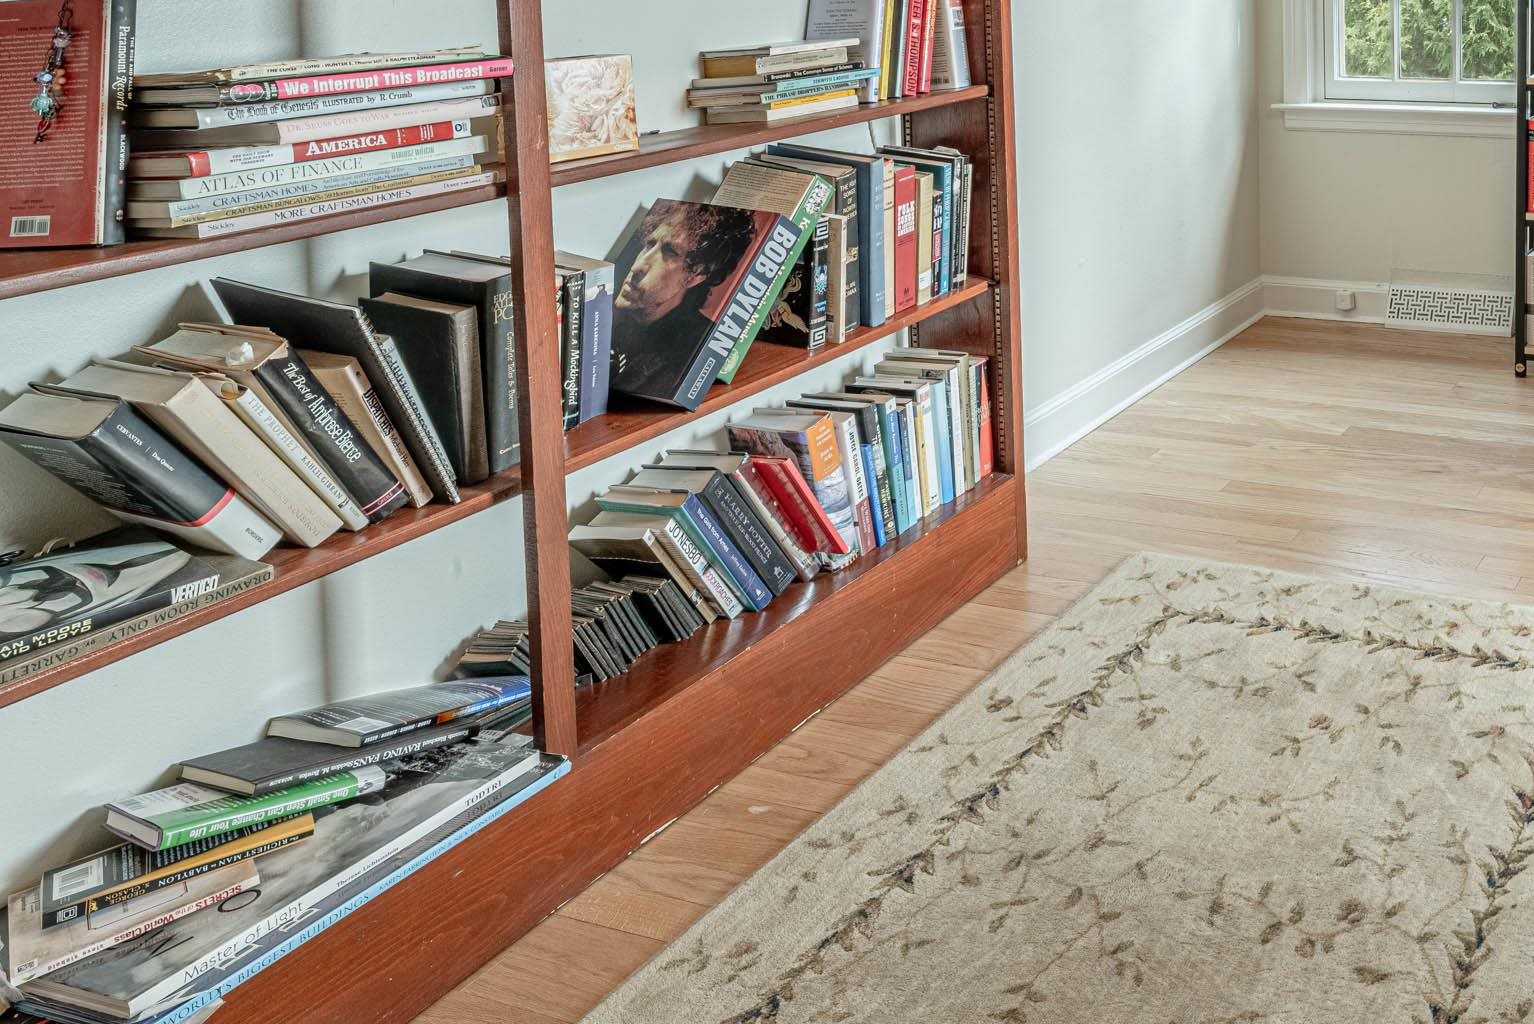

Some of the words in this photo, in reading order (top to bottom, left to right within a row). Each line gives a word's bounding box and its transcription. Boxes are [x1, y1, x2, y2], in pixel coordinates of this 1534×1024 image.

[911, 21, 920, 32] S.
[118, 25, 131, 75] Paramount
[794, 69, 802, 77] The
[803, 67, 820, 76] Common
[821, 66, 833, 74] Sense
[838, 64, 853, 72] Science
[907, 34, 920, 92] THOMPSON
[284, 79, 308, 96] We
[312, 73, 379, 94] Interrupt
[383, 71, 412, 87] This
[416, 65, 483, 84] Broadcast
[111, 76, 129, 112] Records
[223, 105, 244, 120] The
[246, 102, 268, 118] Book
[269, 101, 279, 115] of
[280, 98, 319, 114] Genesis
[322, 94, 363, 110] ILLUSTRATED
[366, 92, 376, 105] by
[388, 89, 413, 103] Crumb
[118, 133, 126, 170] BLACKWOOD
[305, 134, 387, 156] AMERICA
[198, 171, 257, 194] ATLAS
[261, 167, 284, 185] OF
[290, 156, 363, 180] FINANCE
[213, 189, 278, 208] CRAFTSMAN
[281, 183, 318, 197] HOMES
[840, 184, 850, 192] THE
[225, 201, 273, 217] CRAFTSMAN
[274, 206, 305, 221] MORE
[310, 195, 374, 215] CRAFTSMAN
[376, 189, 412, 204] HOMES
[847, 197, 853, 205] OF
[208, 221, 234, 232] Stickley
[755, 224, 797, 279] BOB
[572, 296, 580, 309] TO
[571, 312, 580, 337] KILL
[708, 277, 771, 357] DYLAN
[738, 313, 760, 343] Music
[506, 330, 515, 360] Complete
[282, 361, 299, 383] The
[563, 345, 580, 406] Mockingbird
[690, 360, 714, 398] CALLAWAY
[293, 377, 311, 399] Best
[303, 388, 317, 402] of
[507, 388, 515, 409] Poems
[308, 395, 344, 439] Ambrose
[362, 388, 394, 438] DISPATCHES
[114, 423, 144, 446] CERVANTES
[150, 451, 162, 462] Don
[247, 396, 265, 417] THE
[263, 413, 300, 453] PROPHET
[300, 454, 323, 479] KAHLIL
[319, 475, 344, 499] GIBRAN
[335, 430, 362, 463] Bierce
[848, 431, 857, 452] JOYCE
[851, 453, 861, 476] CAROL
[855, 475, 864, 499] OATES
[667, 522, 682, 540] JO
[695, 506, 706, 519] The
[702, 516, 713, 529] Girls
[709, 526, 721, 540] from
[717, 537, 730, 553] Ames
[722, 493, 750, 527] HARRY
[746, 524, 774, 559] POTTER
[170, 574, 221, 605] VERTIGO
[204, 571, 272, 605] DRAWING
[154, 599, 200, 624] ROOM
[32, 618, 93, 643] MOORE
[38, 623, 92, 648] LLOYD
[107, 619, 149, 643] ONLY
[352, 752, 379, 767] FANS
[382, 741, 421, 760] RAVING
[306, 791, 330, 809] Small
[332, 787, 349, 802] One
[464, 779, 502, 808] TODTRI
[266, 804, 284, 819] Can
[285, 798, 305, 814] Step
[209, 818, 229, 835] Your
[231, 809, 265, 829] Change
[189, 824, 207, 840] Life
[220, 851, 241, 868] MAN
[242, 836, 288, 860] RICHEST
[158, 862, 208, 888] BABYLON
[335, 868, 362, 888] Therese
[104, 884, 140, 901] CLASON
[109, 888, 146, 905] GEORGE
[194, 883, 242, 913] SECRETS
[174, 905, 185, 921] the
[185, 902, 193, 916] of
[113, 922, 142, 944] Class
[143, 910, 173, 933] World
[81, 942, 103, 958] steve
[183, 938, 237, 984] Master
[244, 924, 262, 949] of
[267, 899, 305, 936] Light
[236, 941, 296, 984] BIGGEST
[299, 892, 371, 944] BUILDINGS
